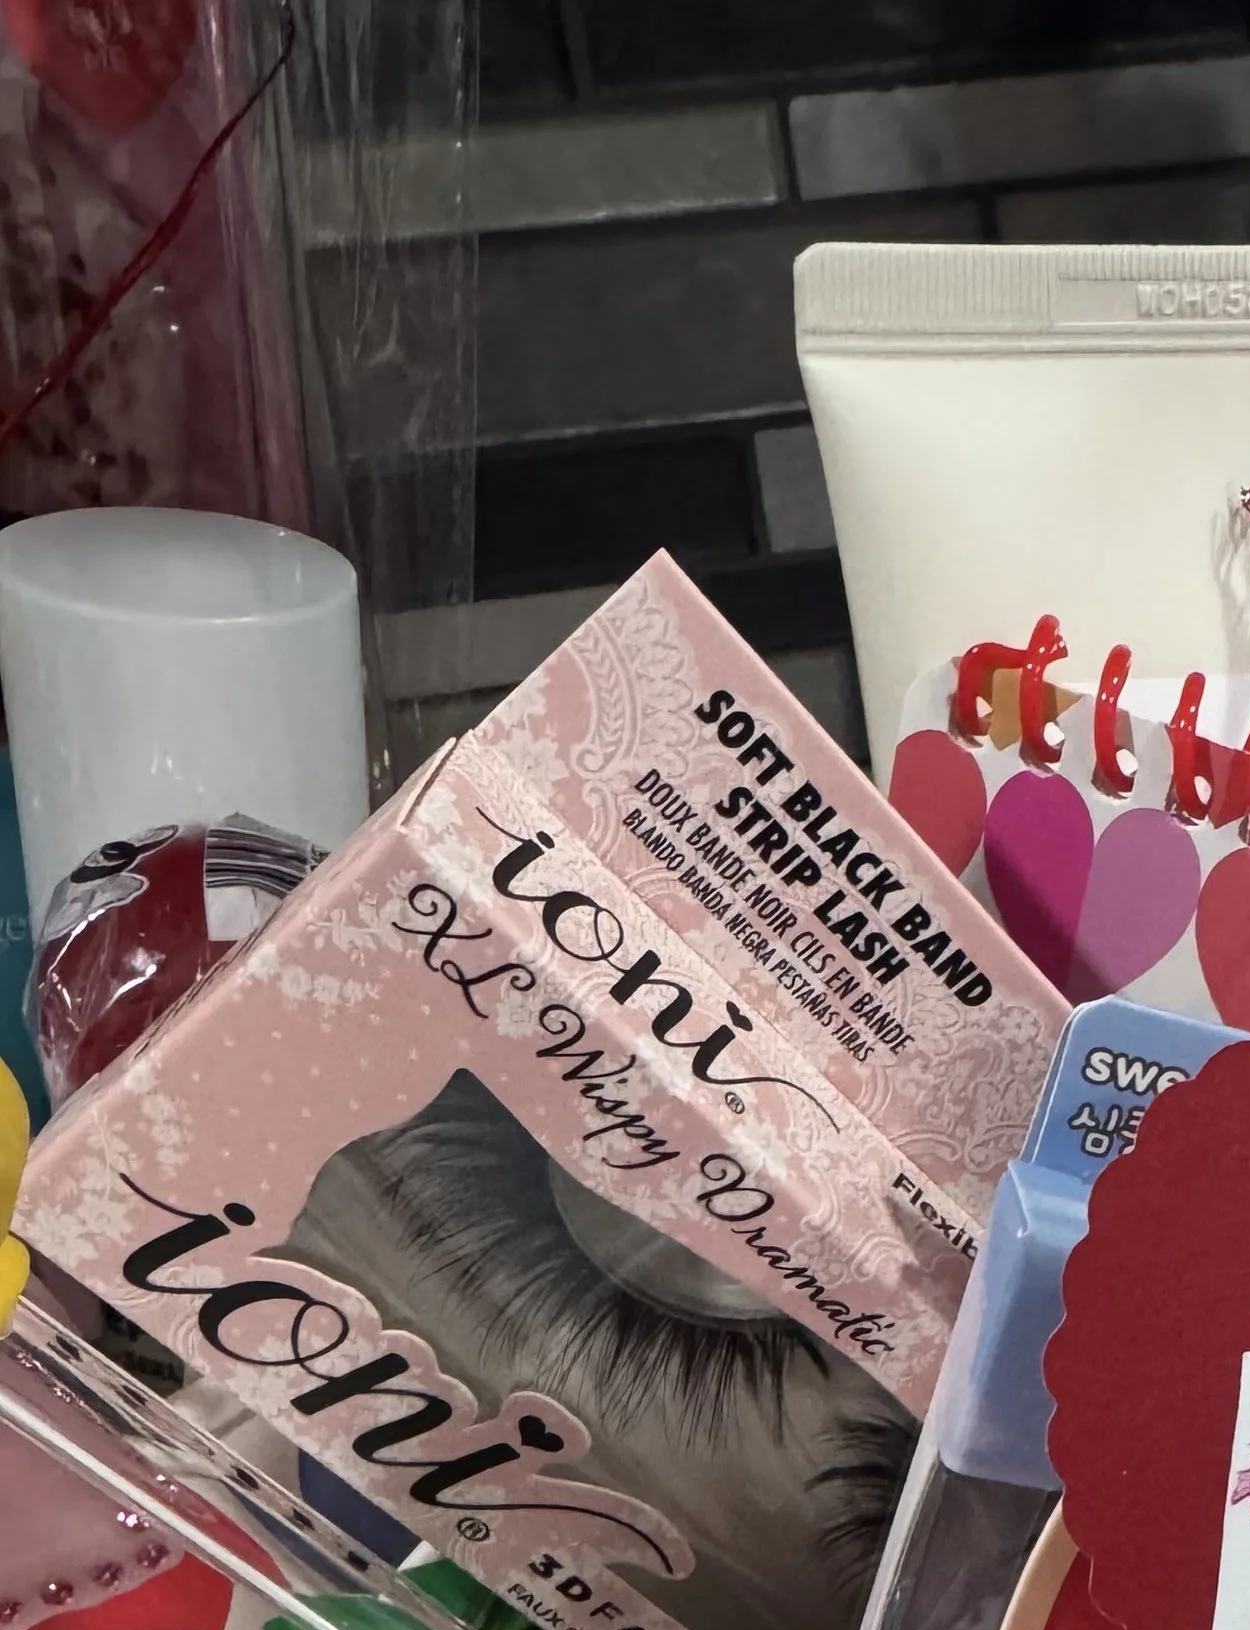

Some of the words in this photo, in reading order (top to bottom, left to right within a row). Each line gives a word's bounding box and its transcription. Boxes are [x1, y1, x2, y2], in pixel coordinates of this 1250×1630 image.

[476, 806, 840, 1133] ioni
[622, 807, 687, 872] BLANDO
[678, 865, 727, 921] BANDA
[725, 912, 773, 967] NEGRA
[770, 955, 835, 1028] PESTAÑAS
[830, 1015, 876, 1064] TIRAS
[634, 767, 699, 834] DOUX
[686, 821, 756, 891] BANDE
[747, 878, 798, 938] NOIR
[792, 930, 836, 975] CILS
[824, 967, 861, 1001] EN
[849, 990, 916, 1056] BANDE
[694, 689, 795, 787] SOFT
[784, 779, 906, 915] BLACK
[890, 903, 993, 1007] BAND
[715, 786, 822, 887] STRIP
[813, 889, 910, 985] LASH
[391, 883, 536, 1019] XL
[536, 1003, 680, 1170] Wispy
[696, 1152, 896, 1357] Dramatic
[119, 1172, 676, 1576] ioni
[507, 1582, 566, 1630] FAUX
[528, 1552, 593, 1602] 3D
